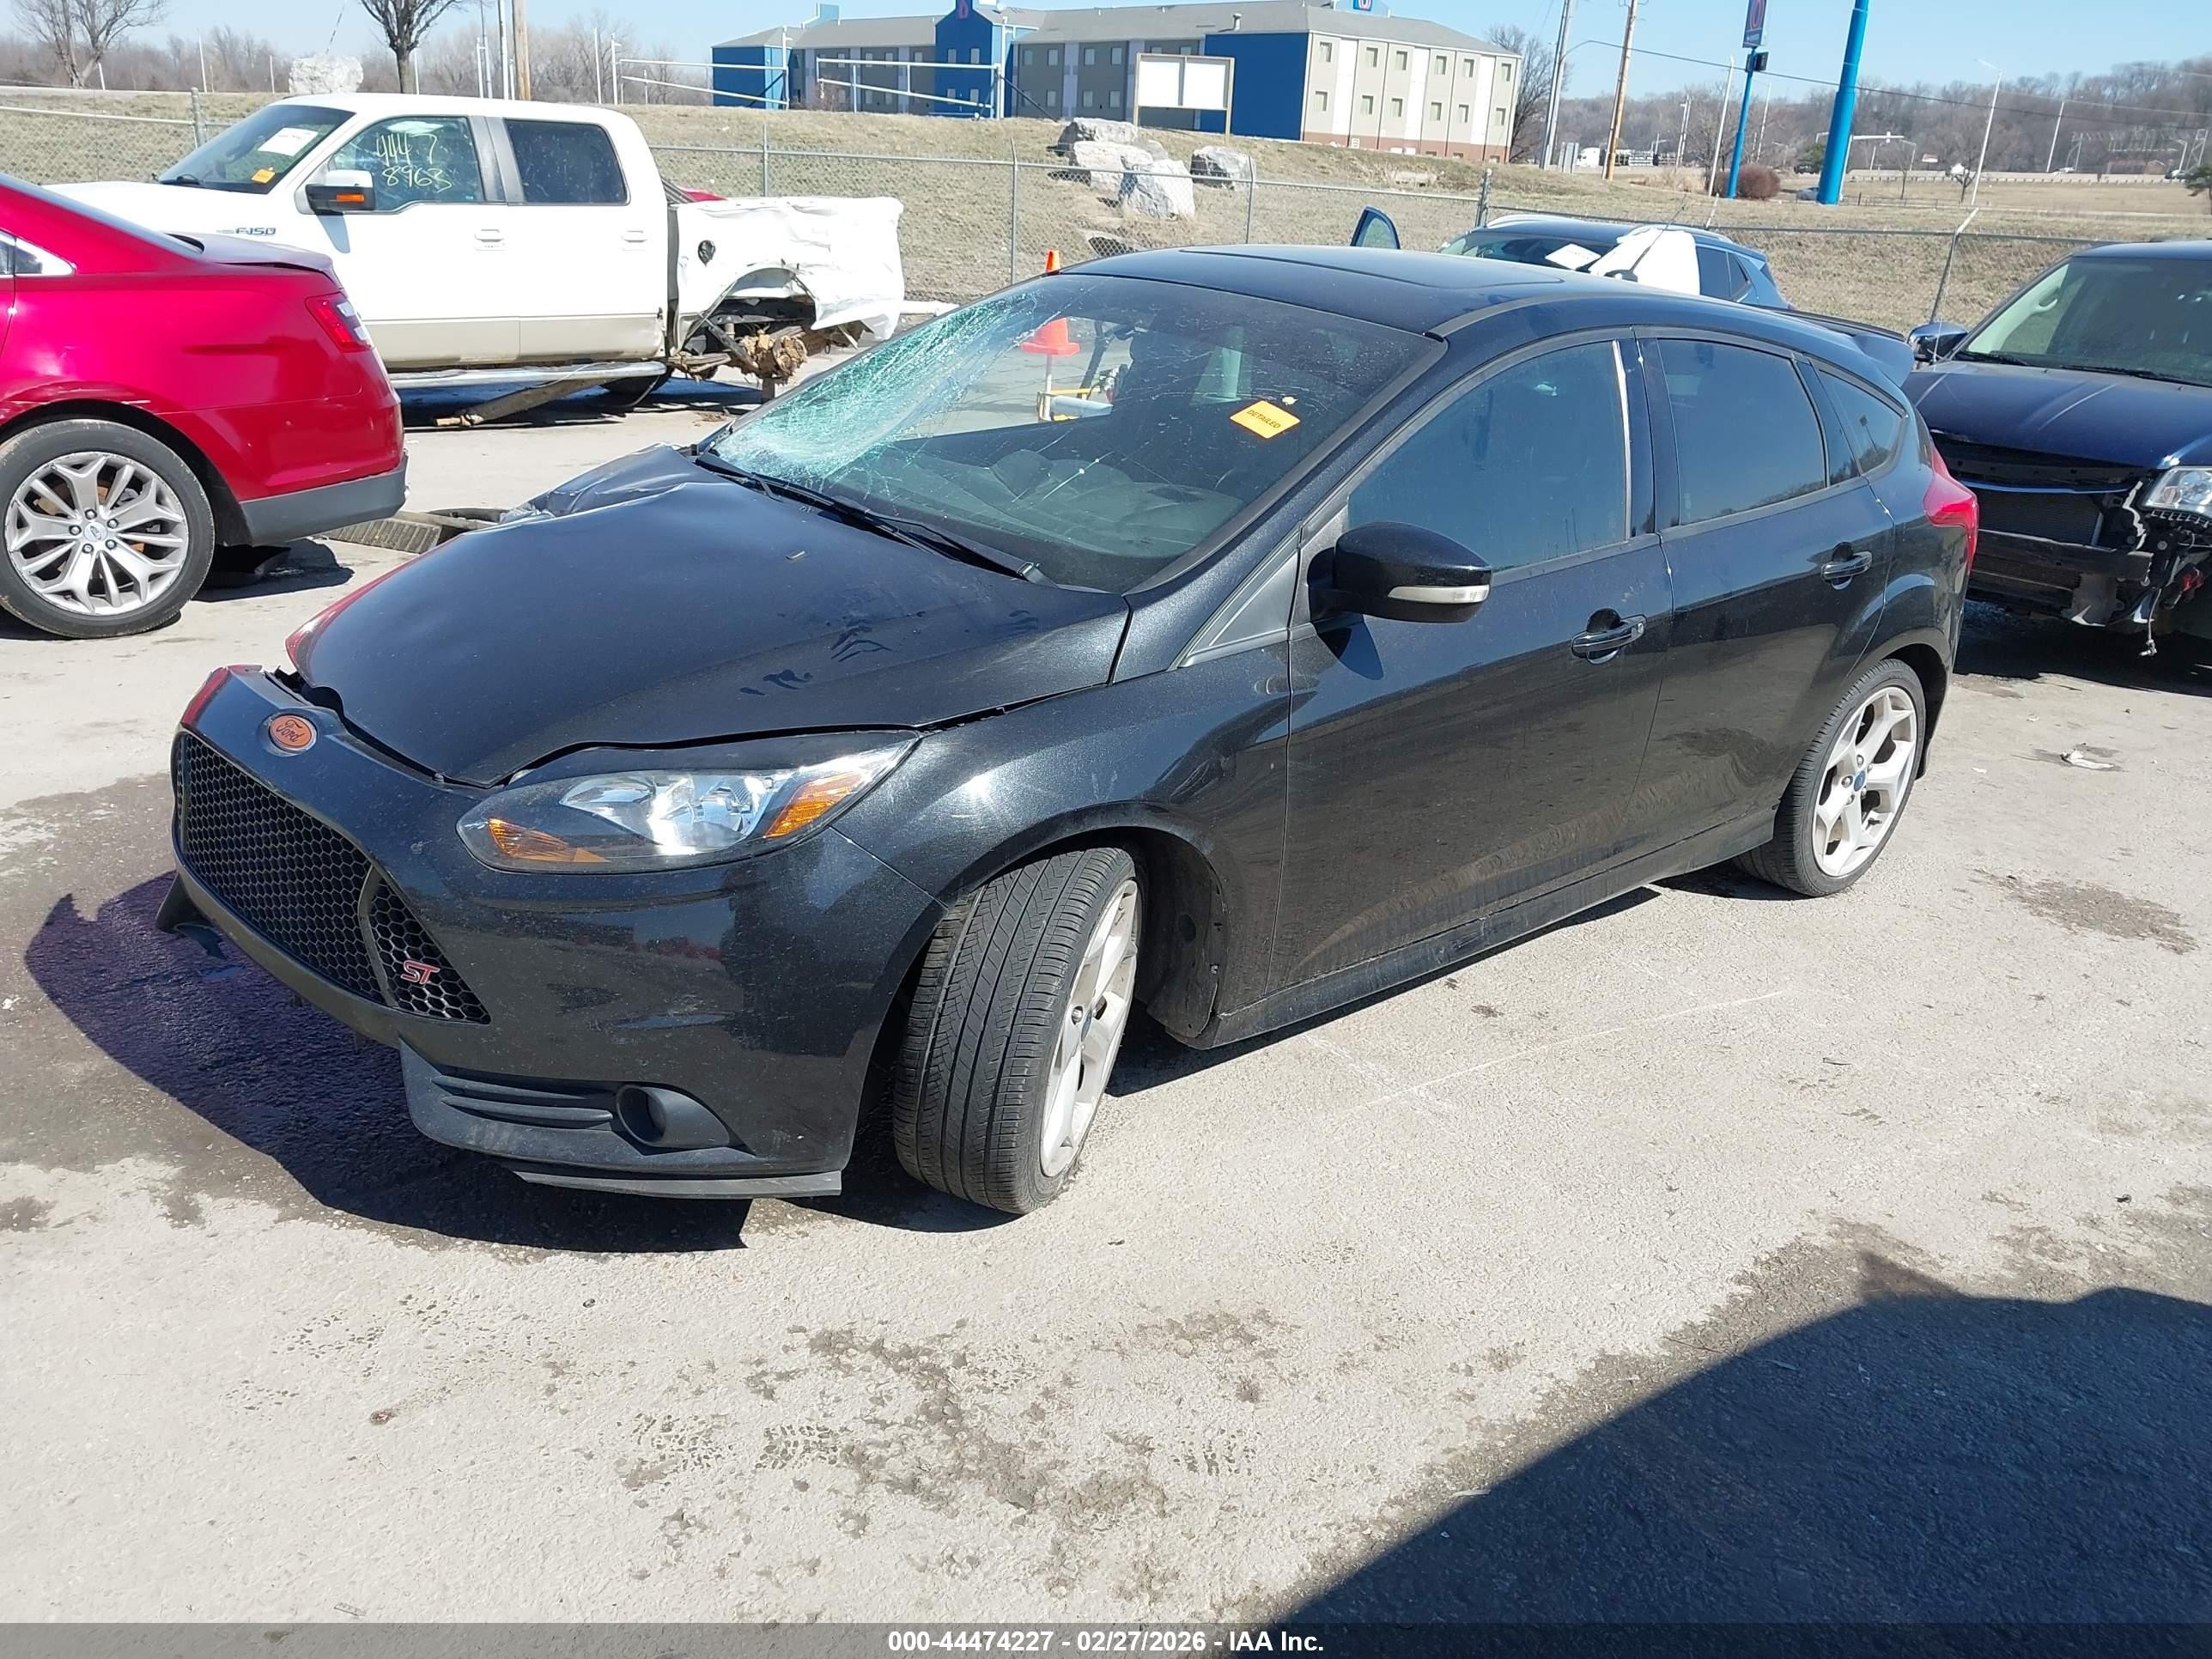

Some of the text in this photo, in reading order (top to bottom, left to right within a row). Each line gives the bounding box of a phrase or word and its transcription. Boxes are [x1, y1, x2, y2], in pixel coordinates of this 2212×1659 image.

[381, 165, 453, 193] 8963
[1246, 409, 1281, 428] DETAILED
[276, 719, 306, 743] Ford
[400, 959, 441, 985] ST
